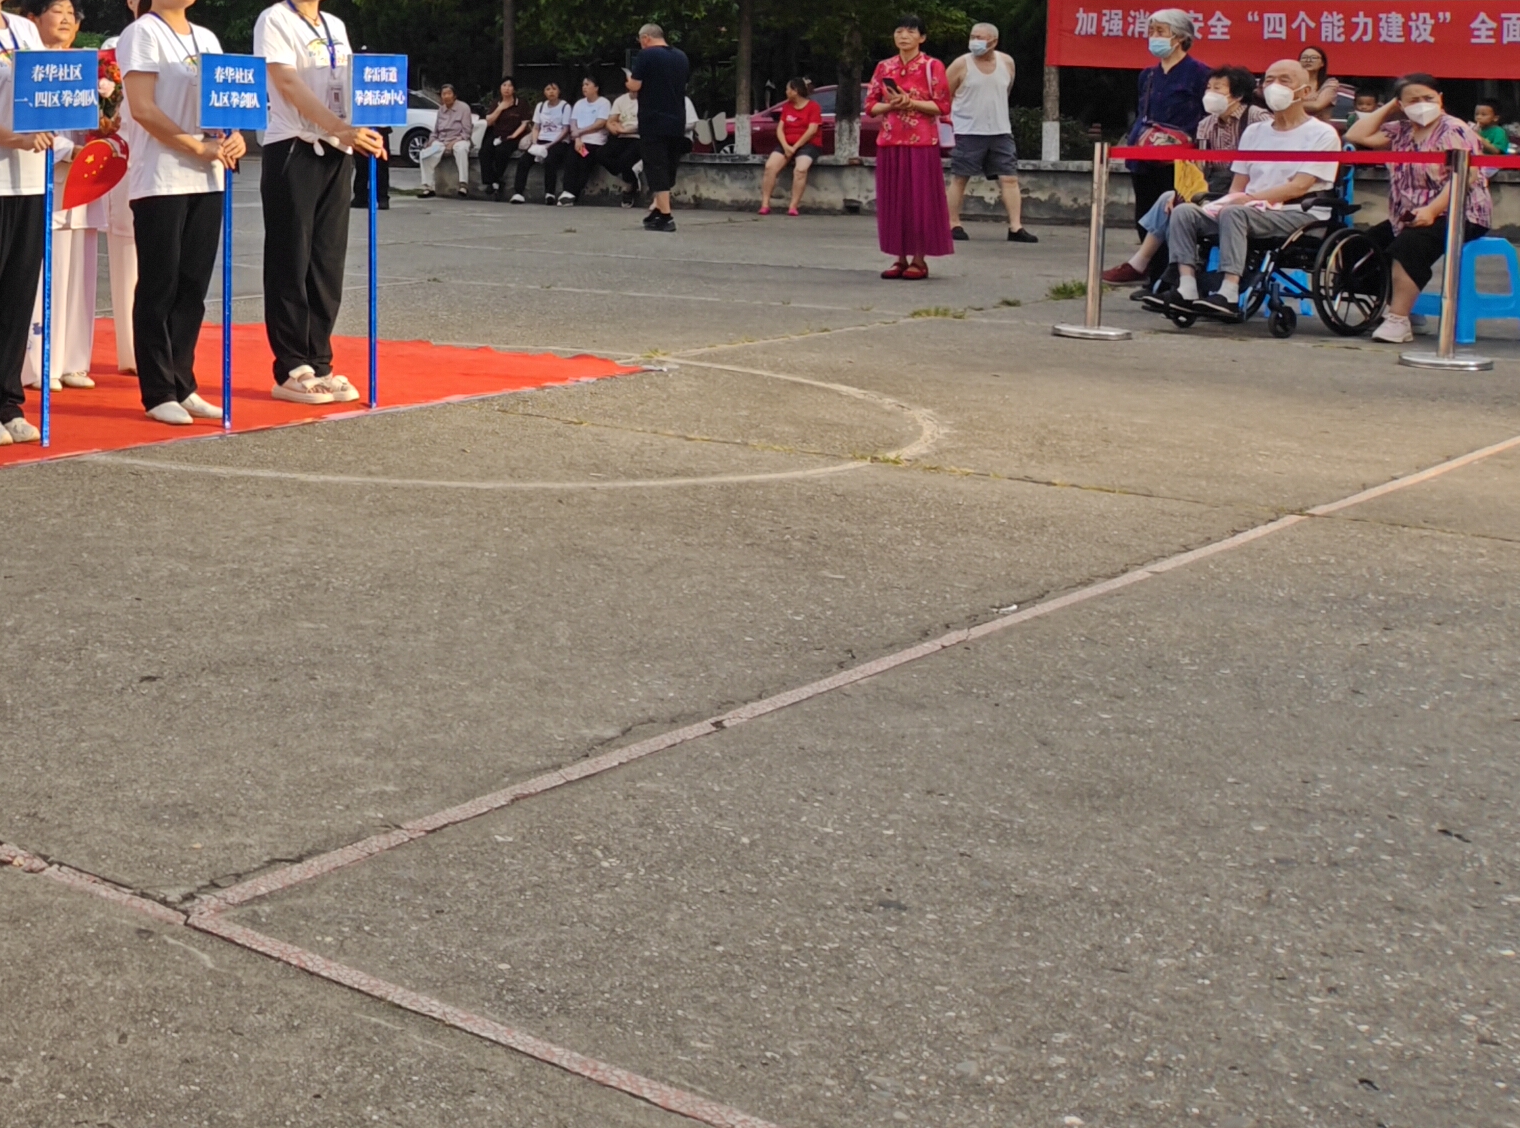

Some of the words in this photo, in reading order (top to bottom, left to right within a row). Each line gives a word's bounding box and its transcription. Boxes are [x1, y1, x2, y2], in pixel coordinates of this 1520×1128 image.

[32, 64, 82, 82] 春华社区
[215, 67, 254, 83] 春华社区
[364, 67, 397, 82] 春雷街道
[210, 91, 260, 108] 九区拳剑队
[355, 90, 405, 105] 拳剑活动中心
